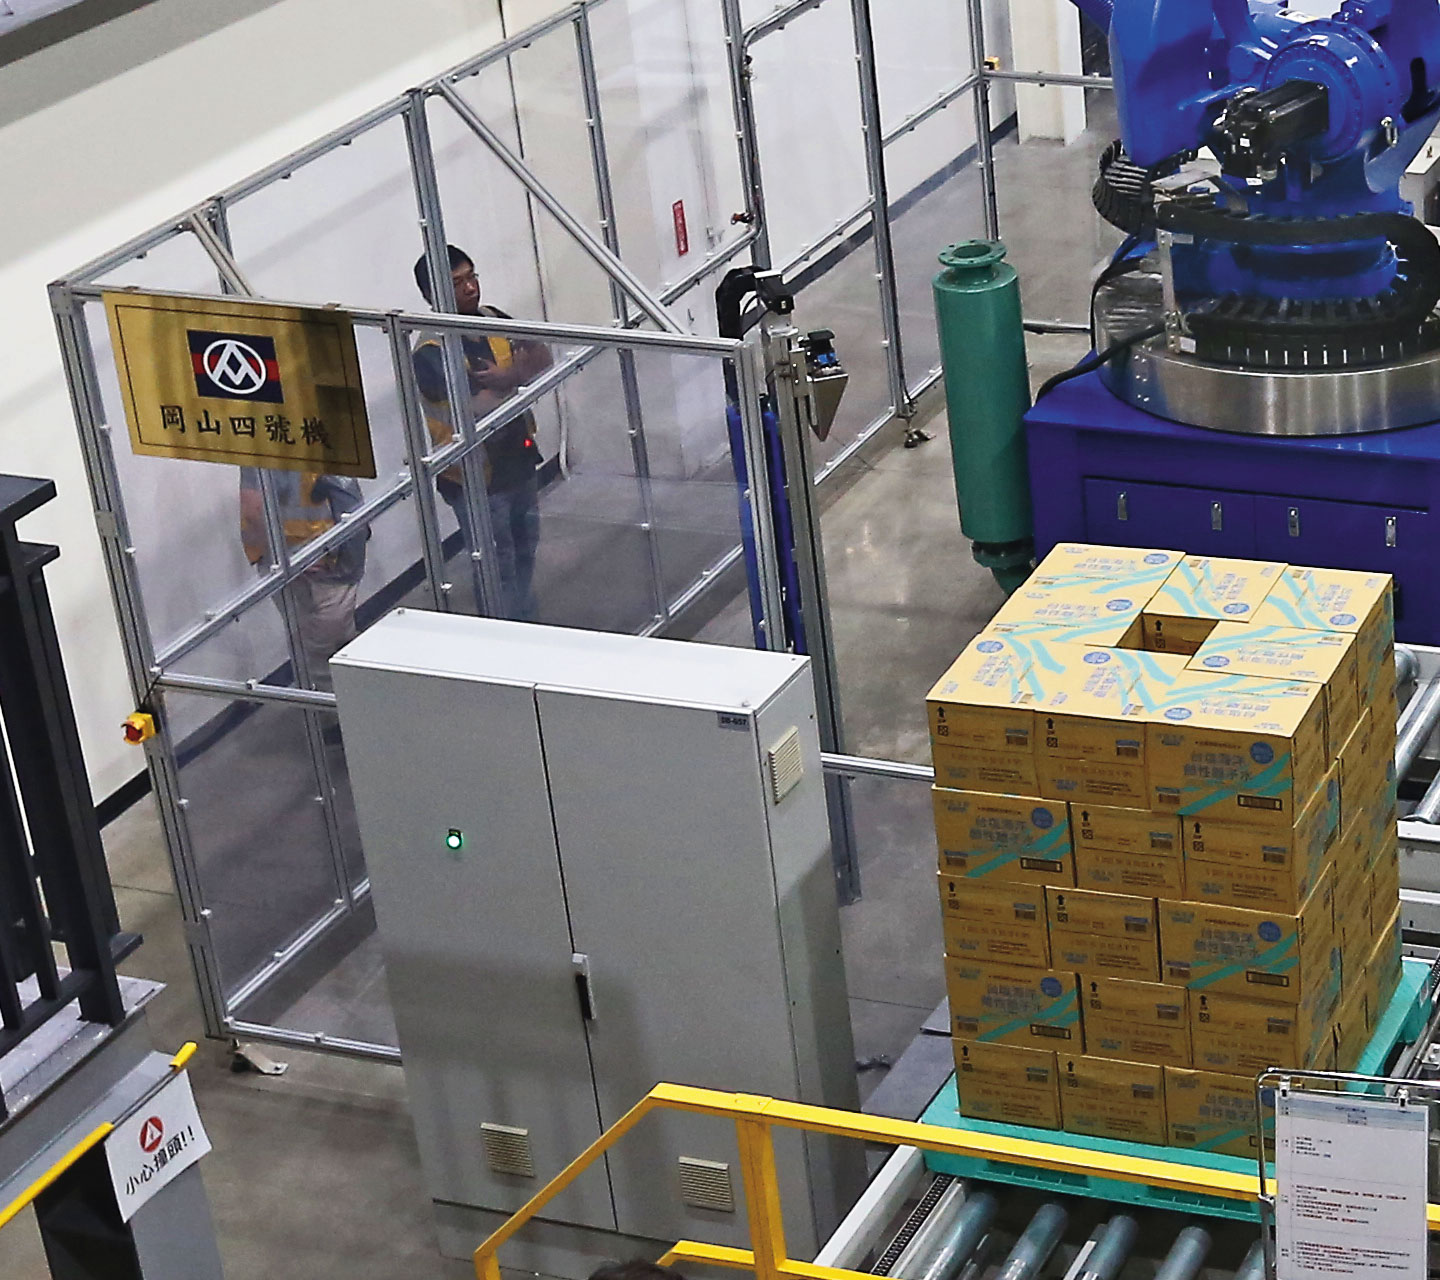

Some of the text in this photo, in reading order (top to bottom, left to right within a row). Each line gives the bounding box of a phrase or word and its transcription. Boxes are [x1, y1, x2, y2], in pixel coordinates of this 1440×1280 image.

[160, 404, 333, 449] 岡山四號機
